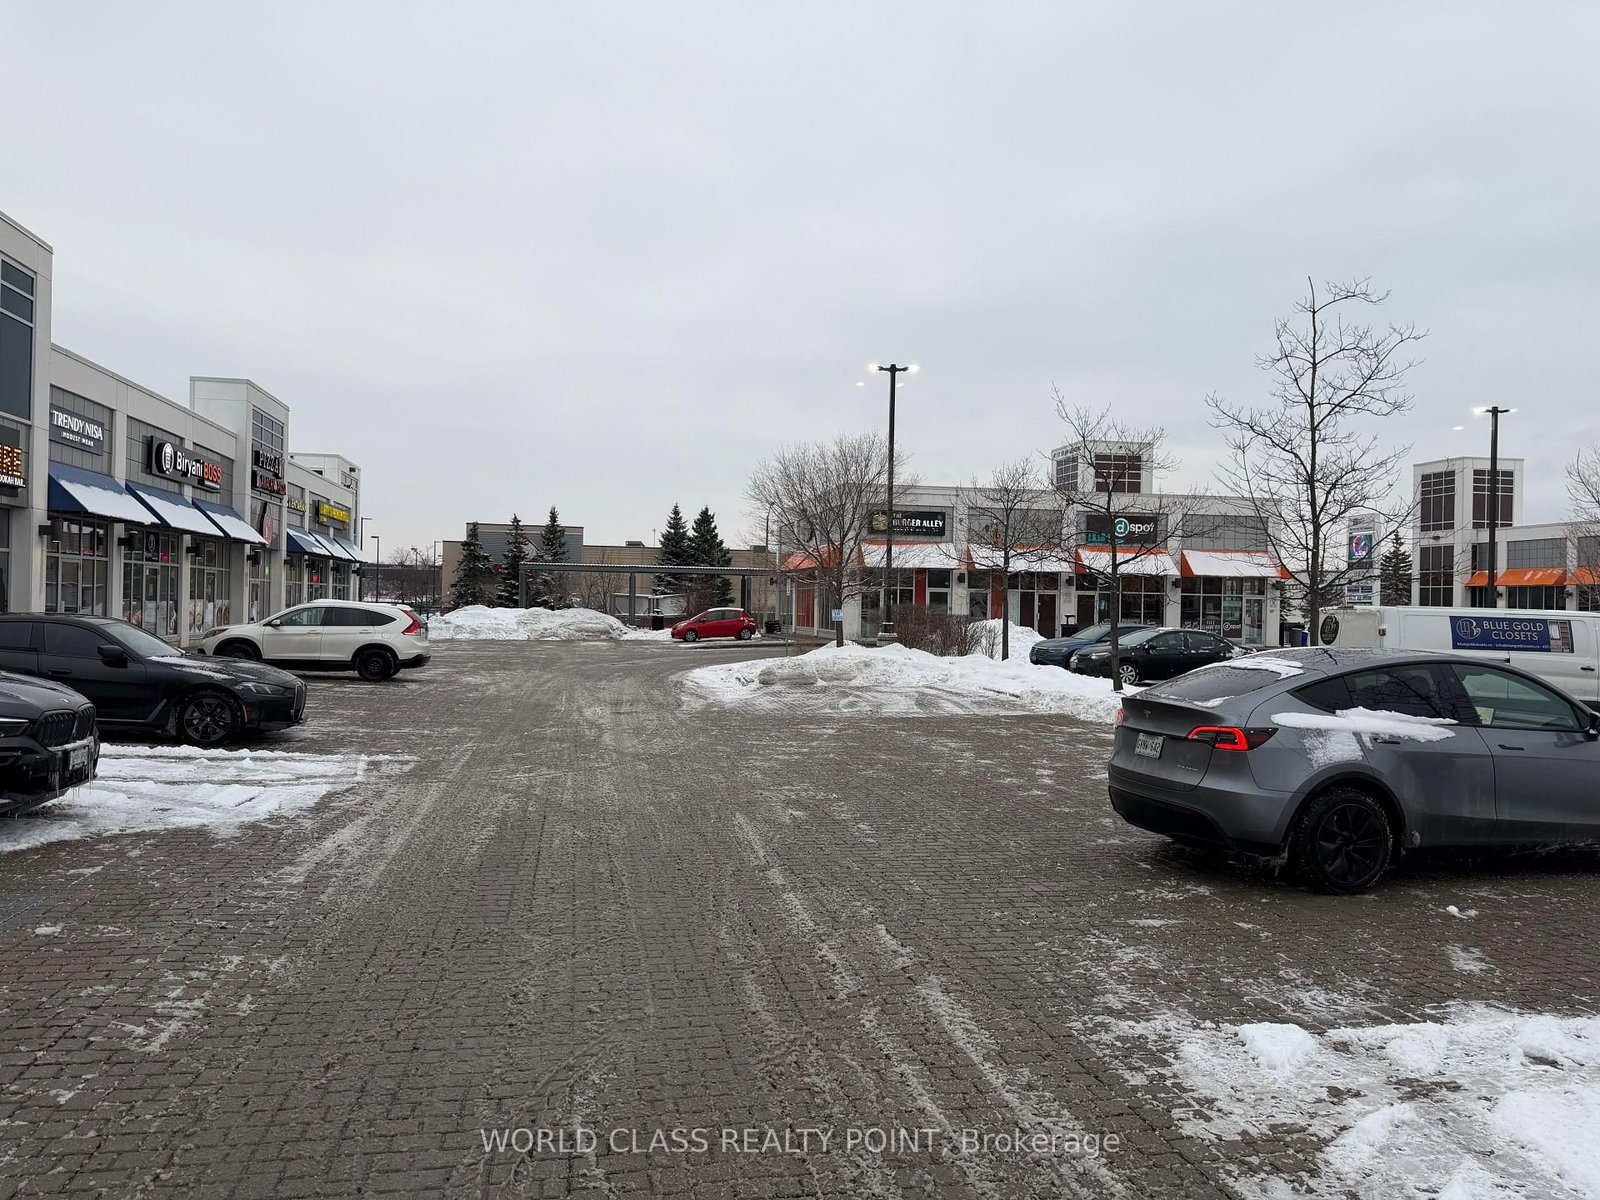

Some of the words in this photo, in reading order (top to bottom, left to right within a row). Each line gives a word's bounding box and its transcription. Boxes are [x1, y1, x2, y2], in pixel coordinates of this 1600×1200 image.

[52, 410, 85, 433] TRENDY
[85, 422, 104, 441] NISA
[0, 444, 22, 476] RE
[176, 450, 203, 478] Biryani
[203, 461, 222, 483] BOSS
[259, 449, 280, 475] PIZZA
[921, 520, 944, 528] ALLEY
[1483, 621, 1510, 630] BLUE
[1512, 622, 1544, 631] GOLD
[1491, 631, 1539, 641] CLOSETS
